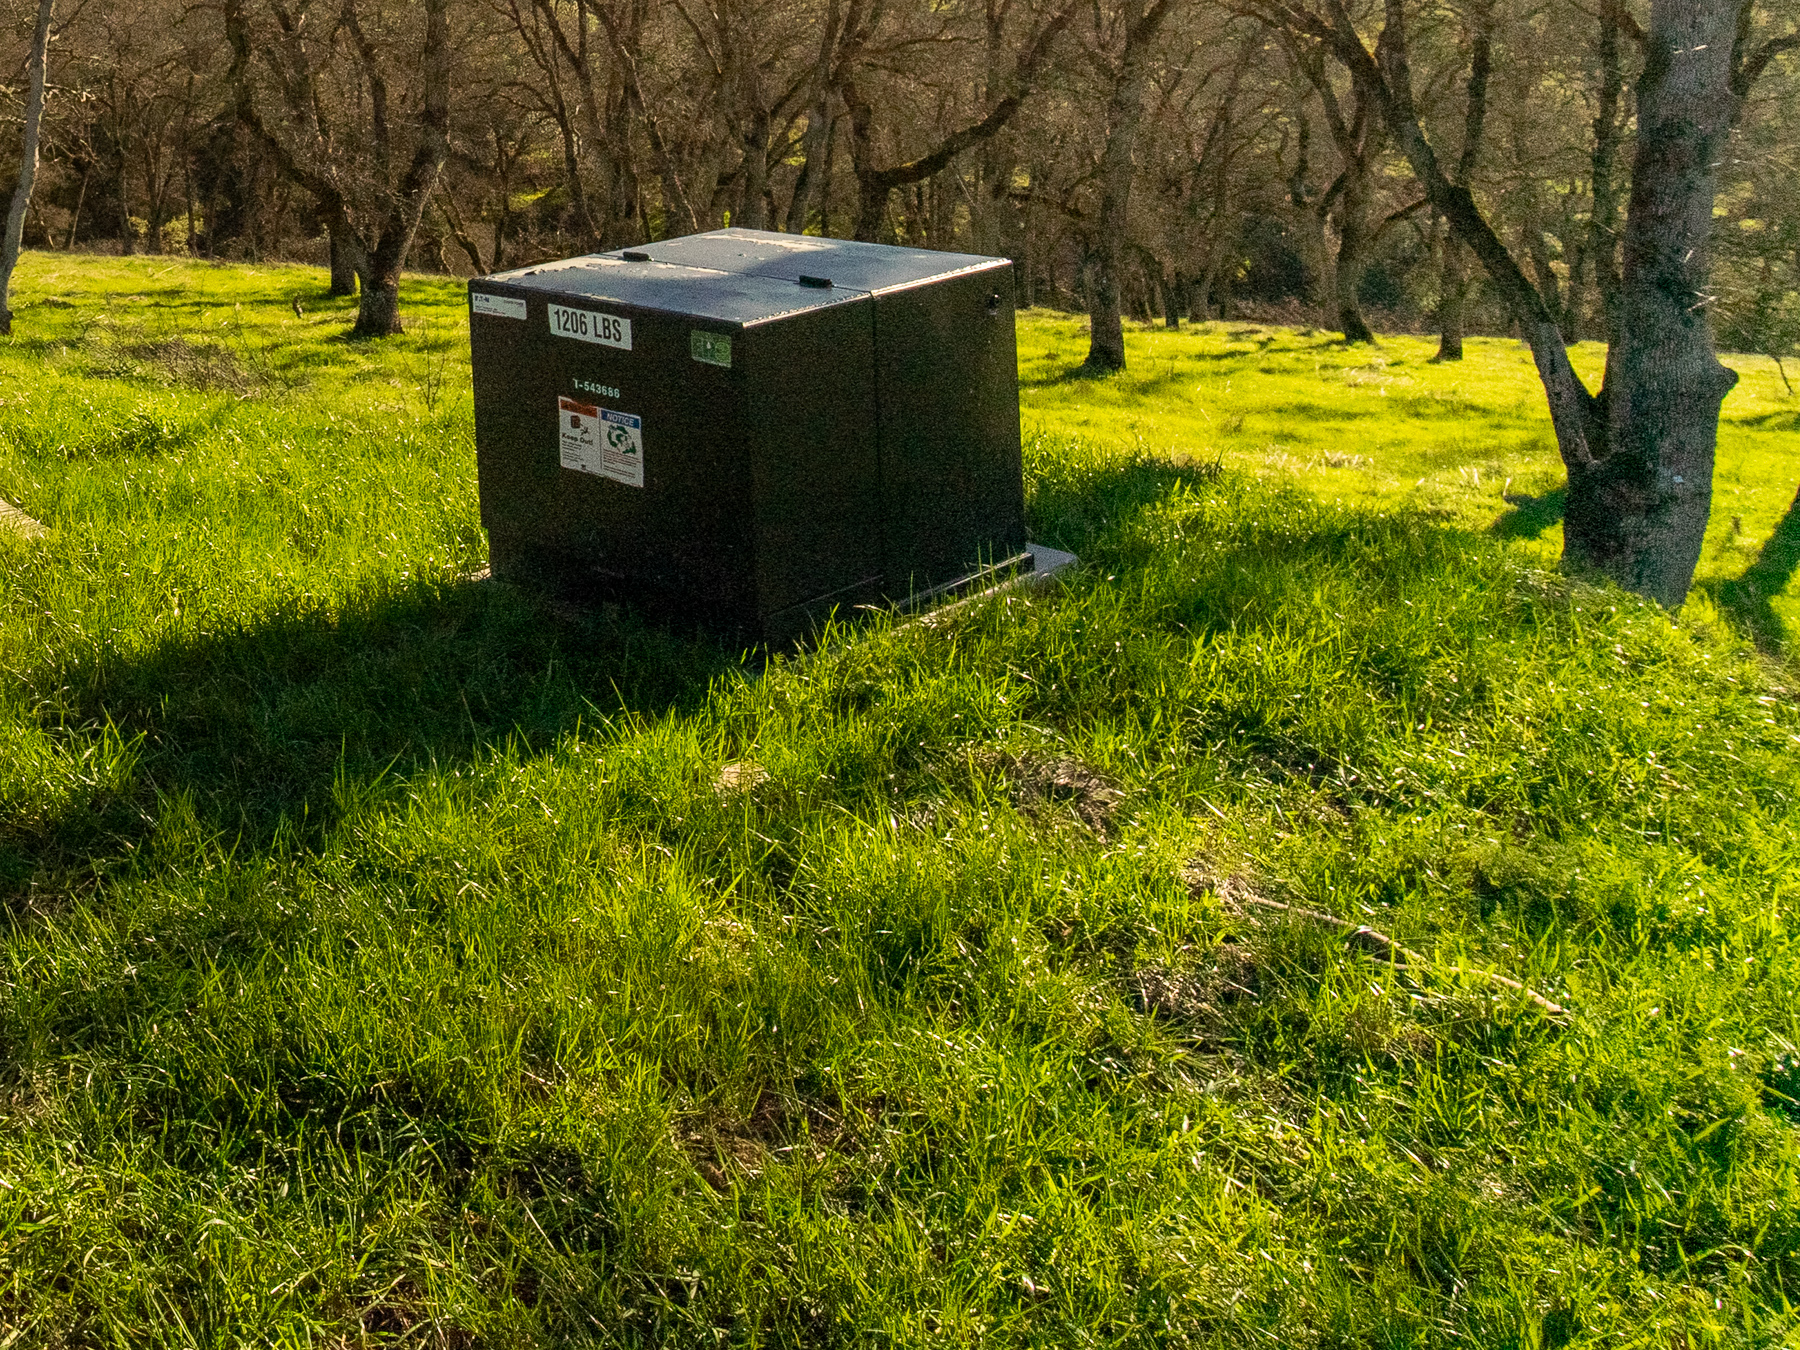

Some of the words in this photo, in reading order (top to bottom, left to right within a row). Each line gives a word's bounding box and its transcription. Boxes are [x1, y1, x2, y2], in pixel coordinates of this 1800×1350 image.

[554, 308, 588, 335] 1206
[593, 315, 622, 342] LBS
[606, 413, 635, 426] NOTICE
[562, 433, 579, 442] Keep
